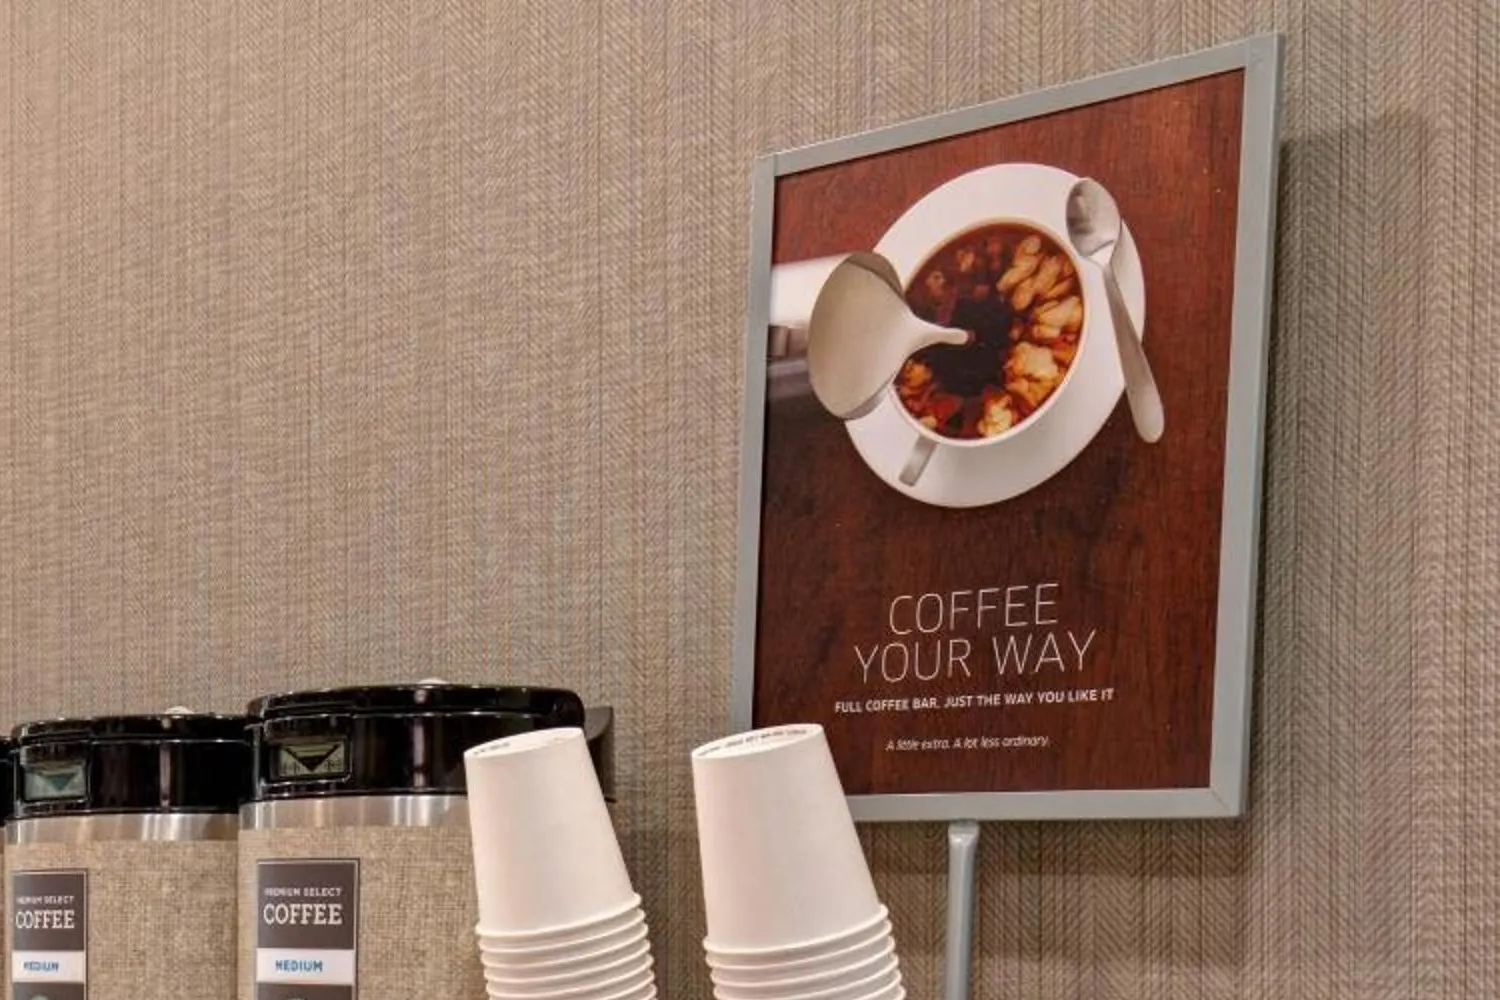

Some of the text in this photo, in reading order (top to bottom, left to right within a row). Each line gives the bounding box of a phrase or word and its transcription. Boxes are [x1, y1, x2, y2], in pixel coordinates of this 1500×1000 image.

[889, 582, 1059, 635] COFFEE
[854, 628, 1097, 684] YOUR WAY
[834, 701, 862, 713] FULL
[865, 699, 910, 711] COFFEE
[944, 695, 973, 708] JUST
[976, 693, 1001, 706] THE
[1003, 692, 1034, 705] WAY
[1037, 690, 1065, 704] YOU
[1067, 689, 1098, 702] LIKE
[1101, 687, 1115, 700] IT
[885, 740, 895, 751] A
[952, 738, 962, 748] A
[980, 736, 1001, 748] less
[303, 887, 342, 897] SELECT
[16, 909, 75, 929] COFFEE
[263, 903, 343, 925] COFFEE
[23, 961, 59, 973] MEDIUM
[275, 959, 323, 972] MEDIUM
